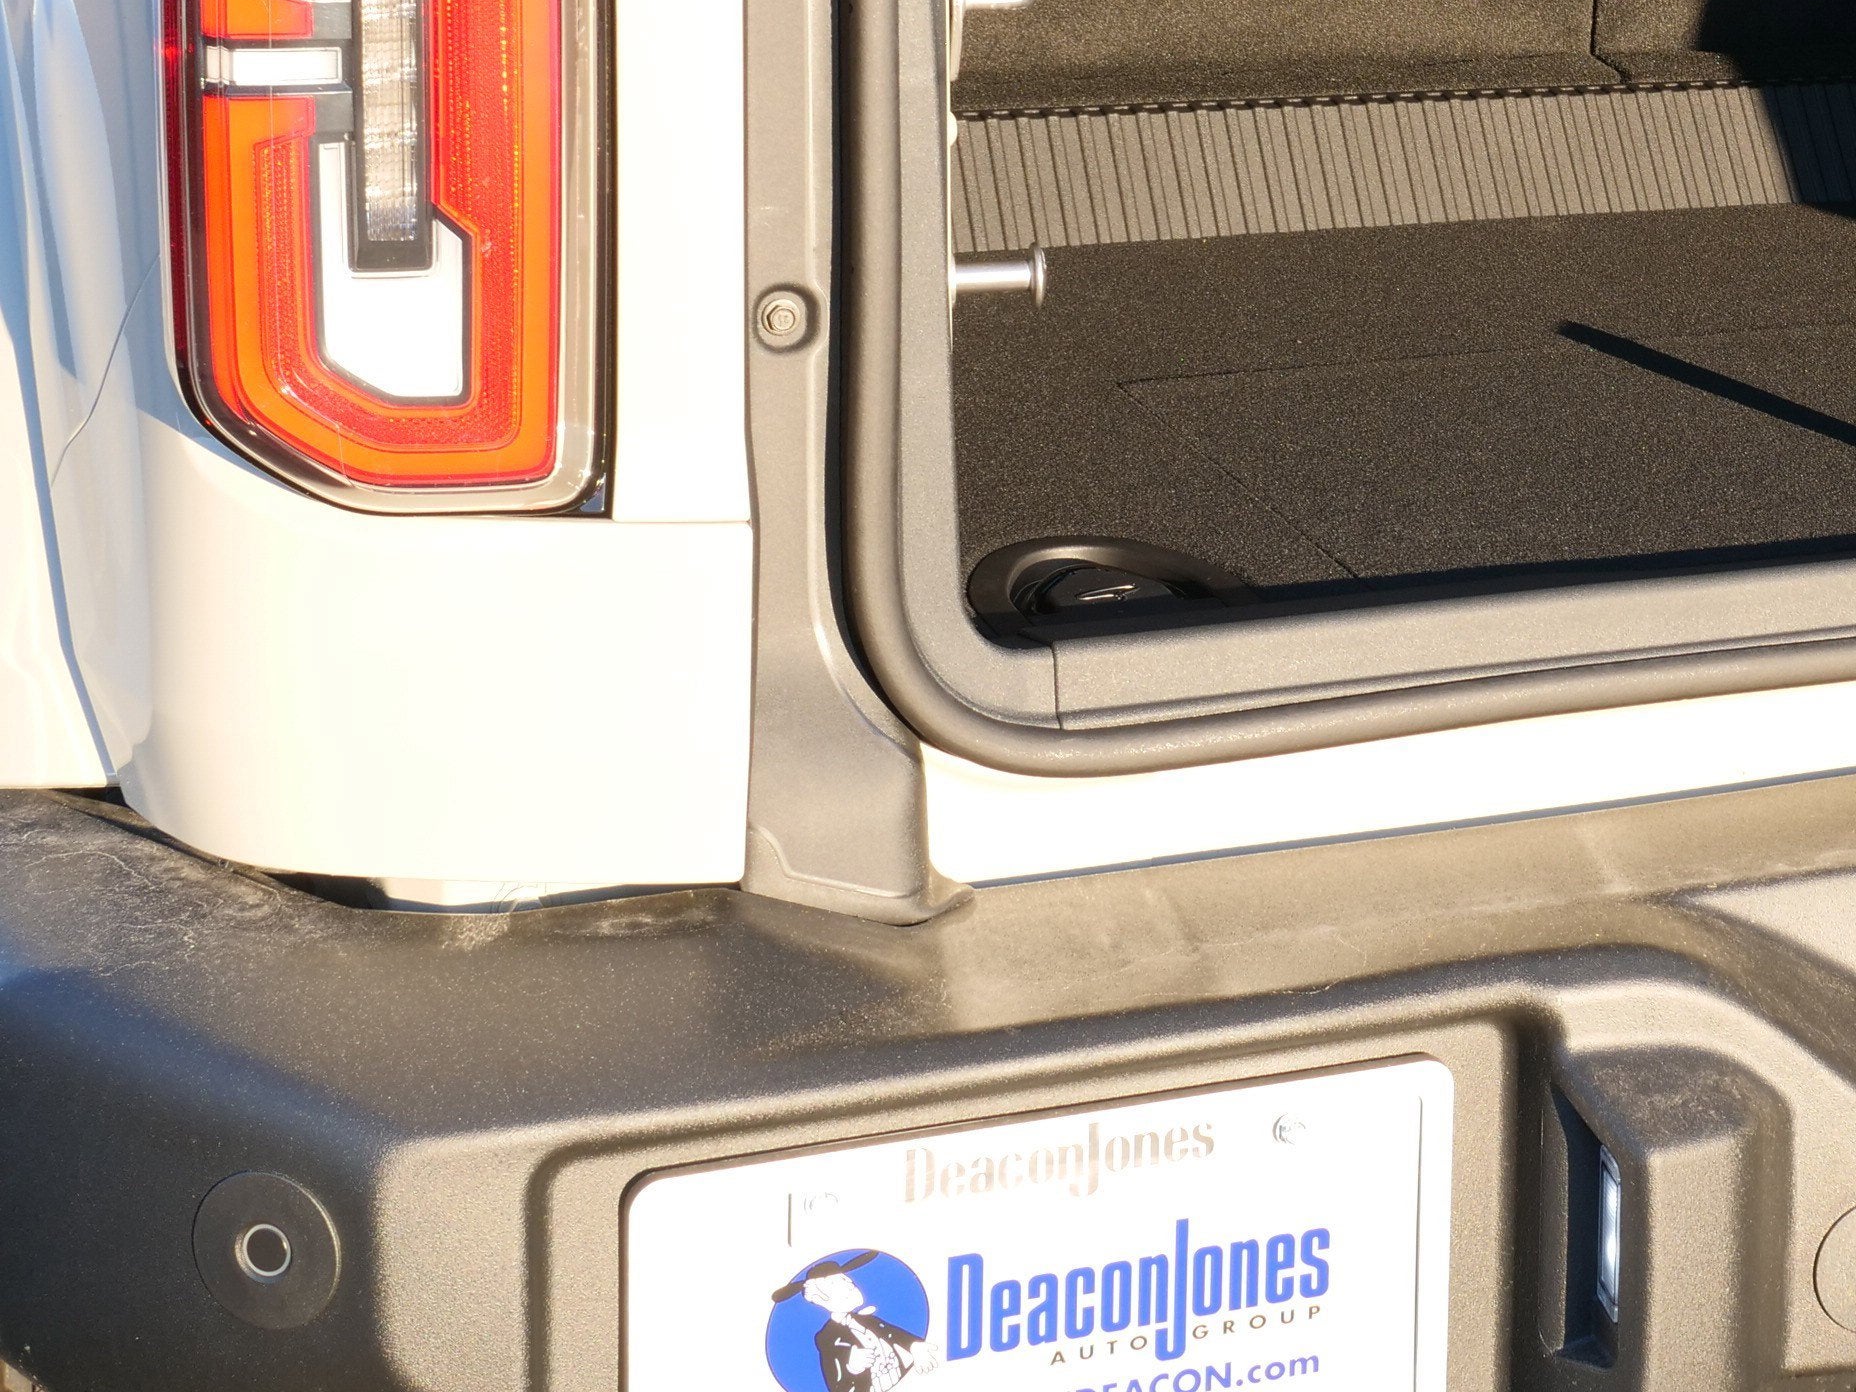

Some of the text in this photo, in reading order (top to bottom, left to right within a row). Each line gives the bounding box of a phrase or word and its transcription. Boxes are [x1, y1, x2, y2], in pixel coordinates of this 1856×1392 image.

[904, 1122, 1215, 1203] DeaconJones
[946, 1218, 1330, 1362] DeaconJones
[1050, 1305, 1321, 1366] AUTO GROUP
